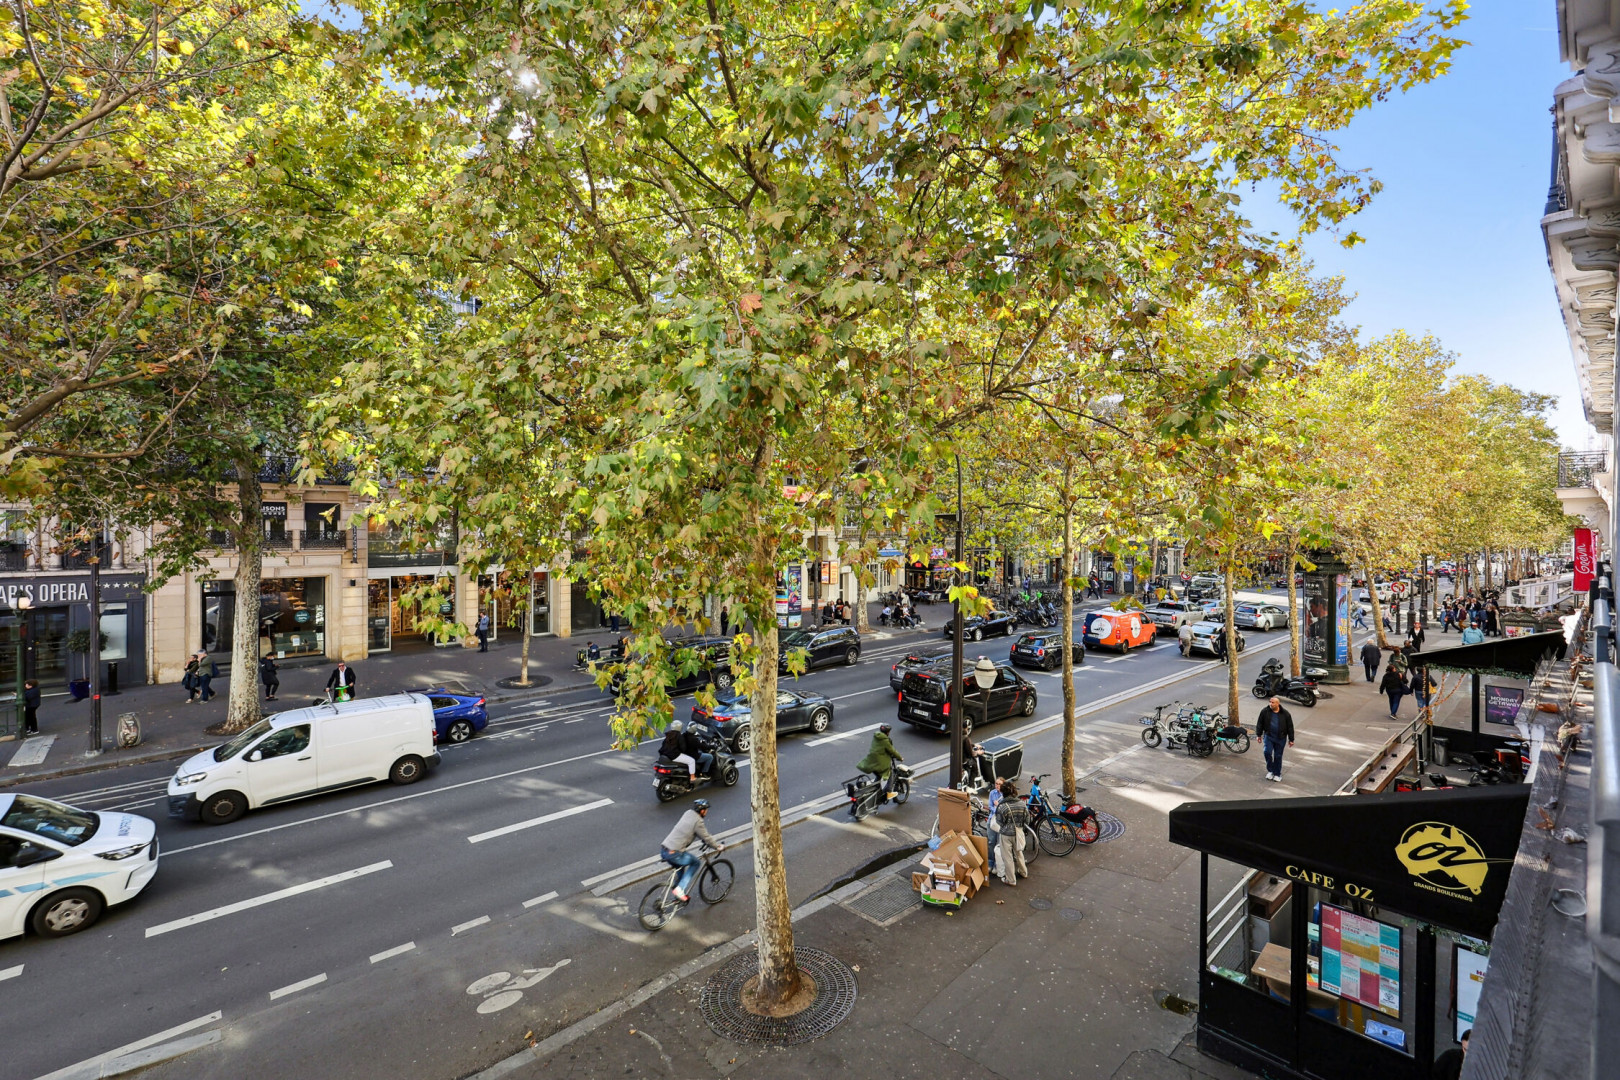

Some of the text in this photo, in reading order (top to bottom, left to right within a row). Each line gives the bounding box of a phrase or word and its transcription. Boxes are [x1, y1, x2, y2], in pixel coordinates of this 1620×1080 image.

[1575, 543, 1591, 574] Grévin
[39, 582, 89, 602] OPERA
[1285, 864, 1375, 902] CAFE OZ
[1413, 880, 1474, 903] GRANDS BOULEVARDS
